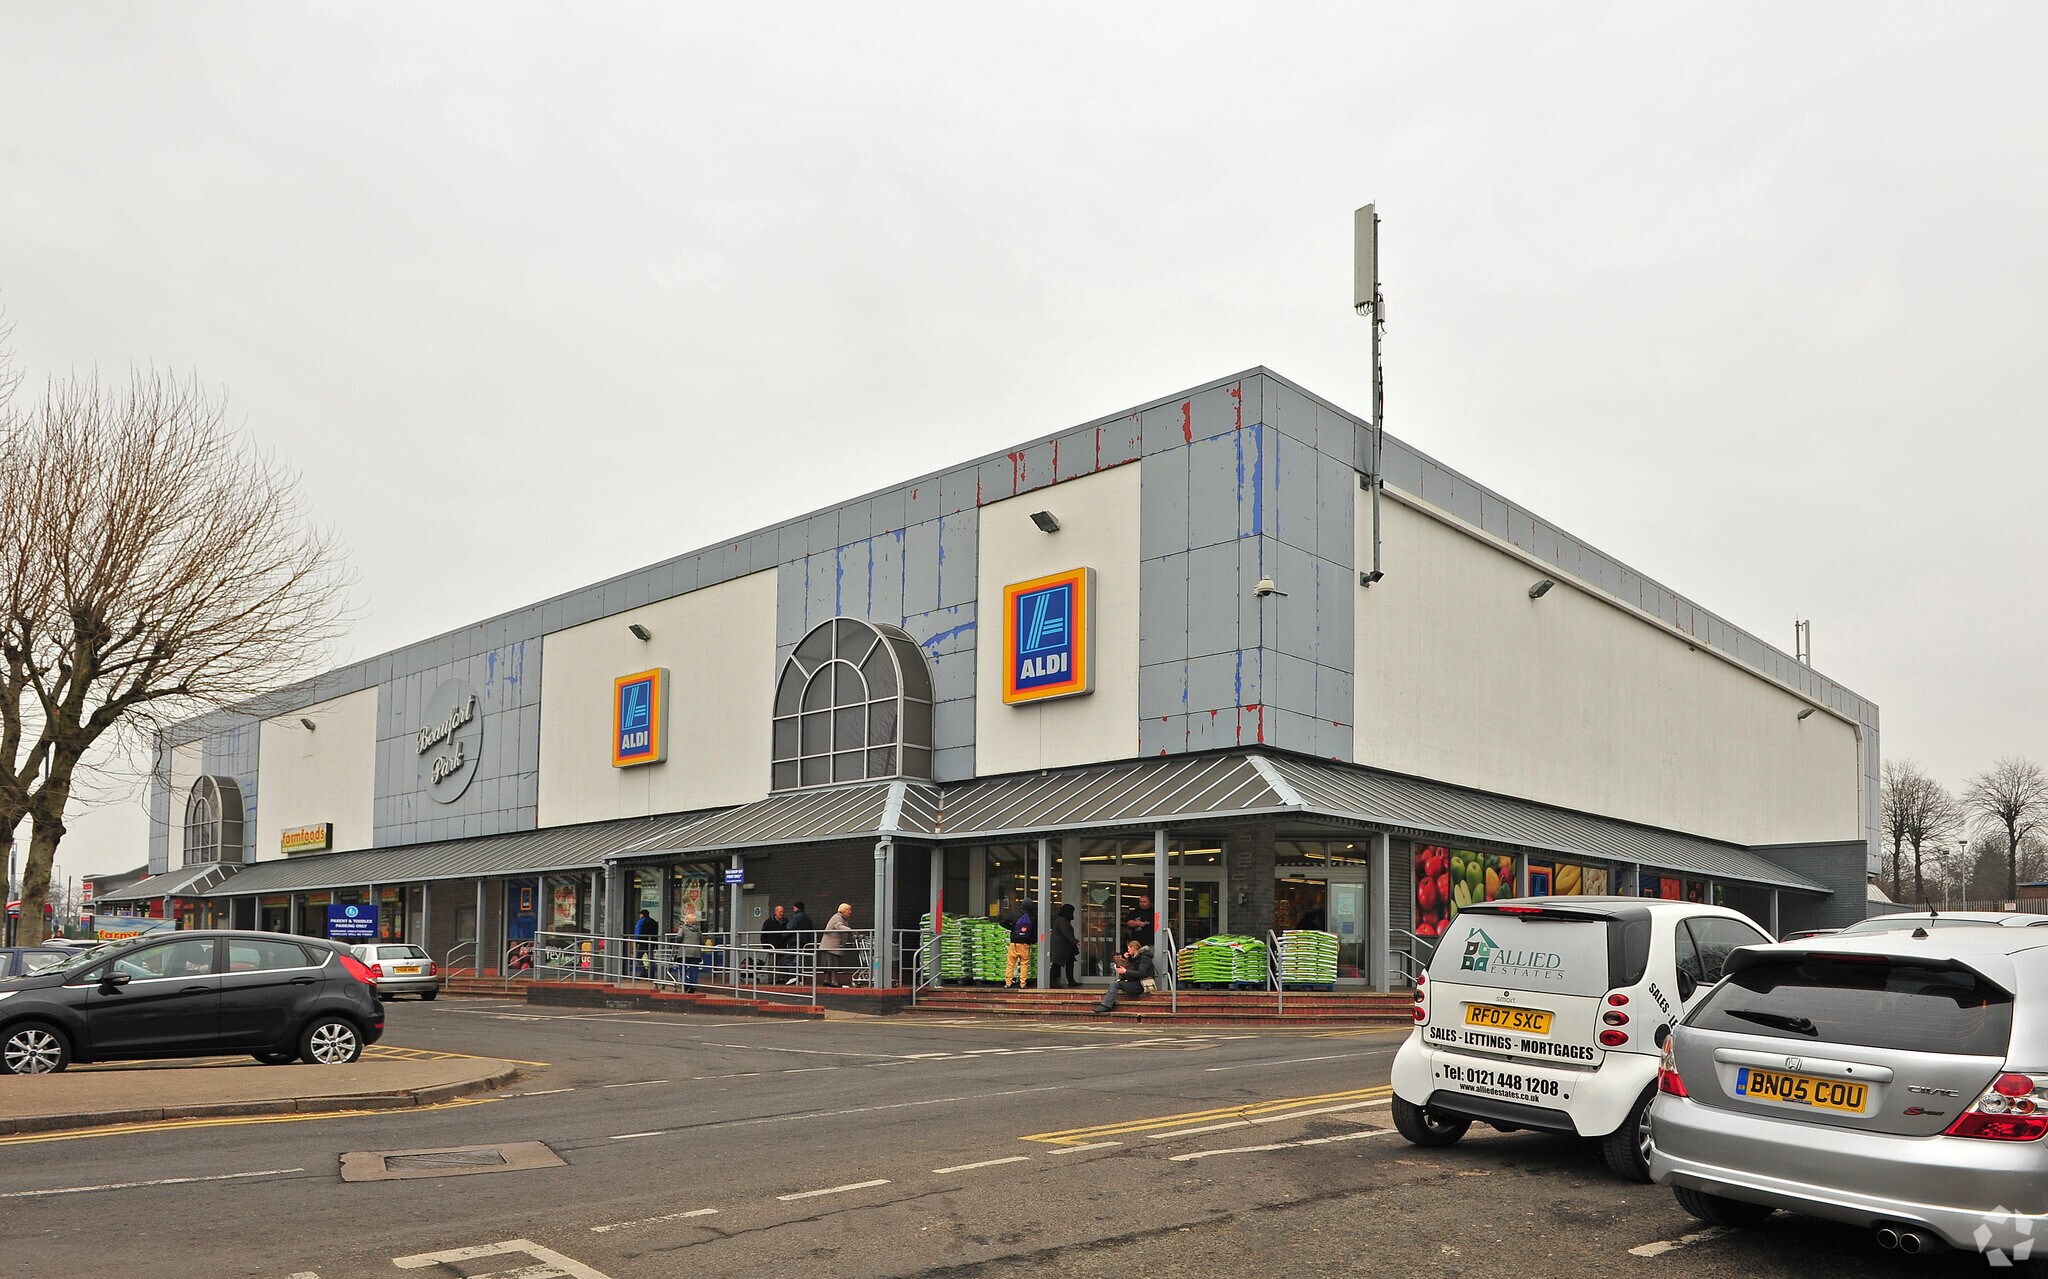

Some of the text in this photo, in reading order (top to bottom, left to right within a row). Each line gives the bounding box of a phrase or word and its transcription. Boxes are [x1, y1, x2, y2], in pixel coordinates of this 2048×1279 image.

[1020, 652, 1067, 679] ALDI
[416, 694, 476, 755] Beaufort
[621, 731, 649, 749] ALDI
[431, 741, 464, 784] Park
[282, 826, 325, 845] farmfoods
[1493, 950, 1561, 968] ALLIED
[1491, 966, 1563, 980] ESTATES
[1648, 982, 1670, 1013] SALES
[1471, 1008, 1544, 1029] RF07 SXC
[1430, 1027, 1456, 1042] SALES
[1464, 1032, 1512, 1050] LETTINGS
[1520, 1039, 1594, 1060] MORTGAGES
[1443, 1064, 1559, 1096] Tel: 0121 448 1208
[1751, 1073, 1863, 1108] BN05 COU
[1908, 1085, 1959, 1097] CIVIC
[1460, 1083, 1540, 1102] www.alliedestates.co.uk
